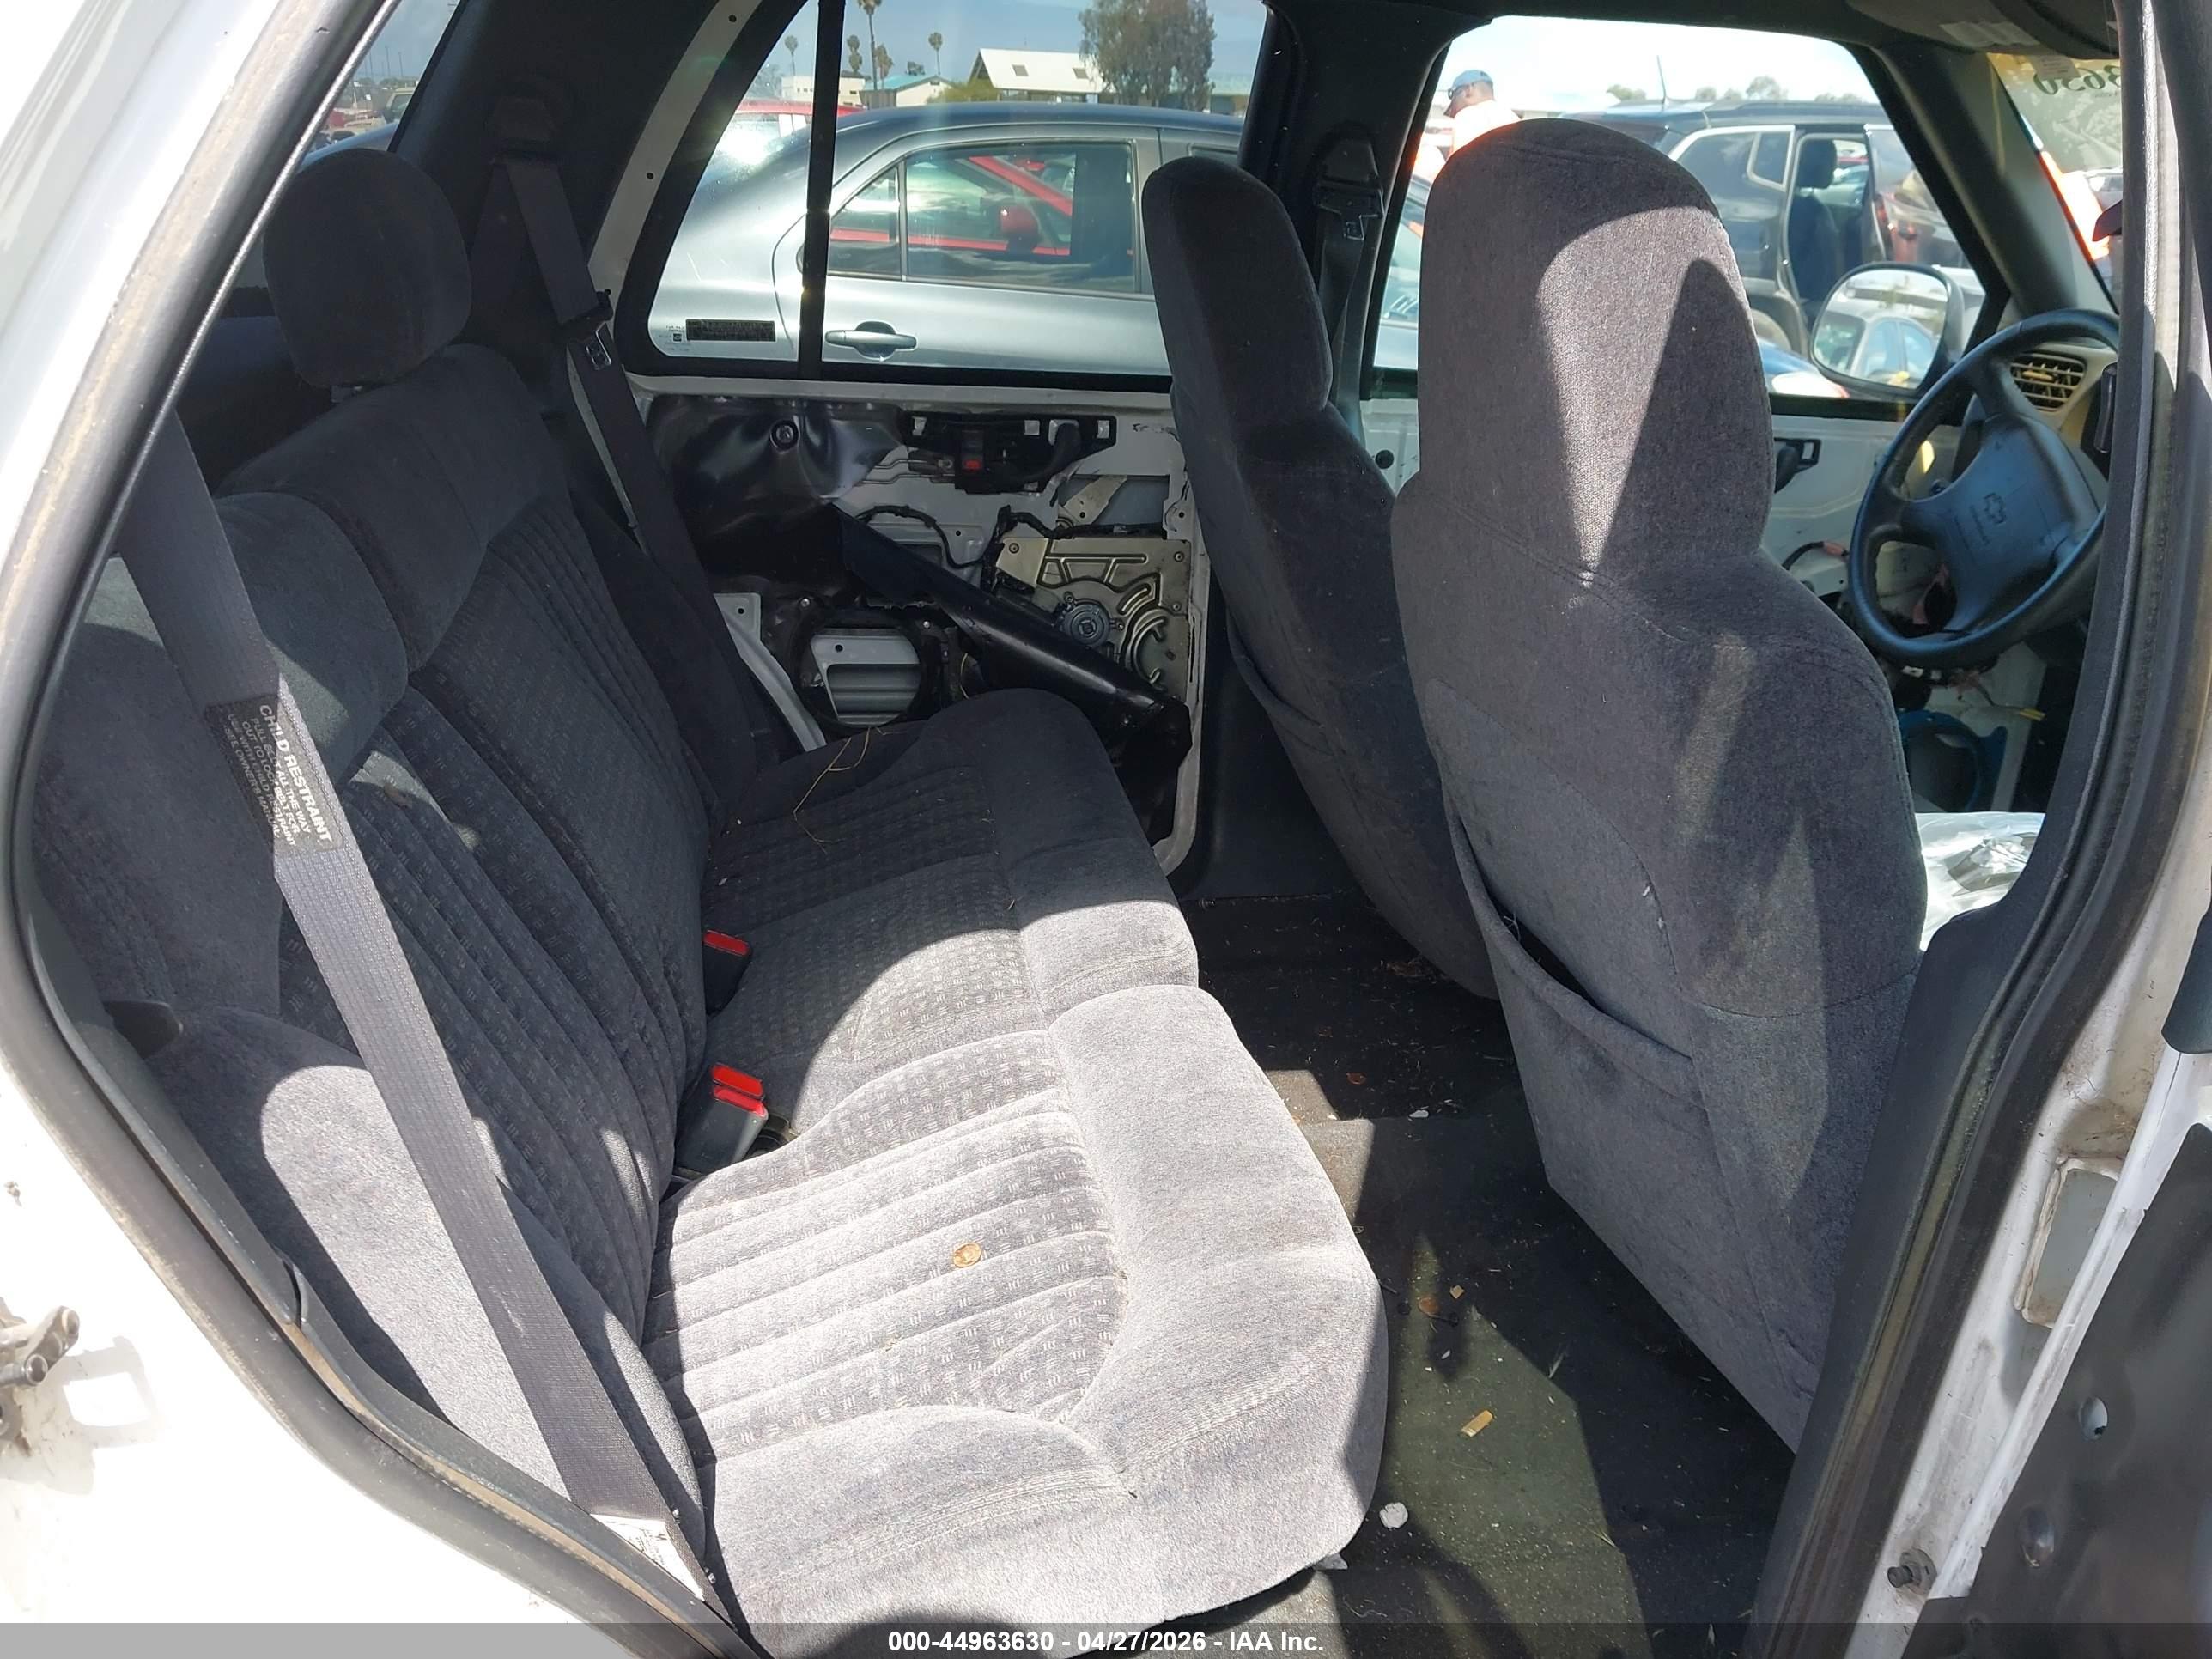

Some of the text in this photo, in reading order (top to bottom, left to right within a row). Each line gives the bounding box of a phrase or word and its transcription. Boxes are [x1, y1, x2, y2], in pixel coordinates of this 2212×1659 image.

[240, 736, 255, 763] WITH
[252, 762, 270, 792] CHILD
[266, 793, 296, 846] RESTRAINT
[242, 720, 301, 834] OUT TO LOCK BELT FOR
[251, 718, 311, 833] PULL BELT ALL THE WAY
[259, 704, 332, 842] CHILD RESTRAINT
